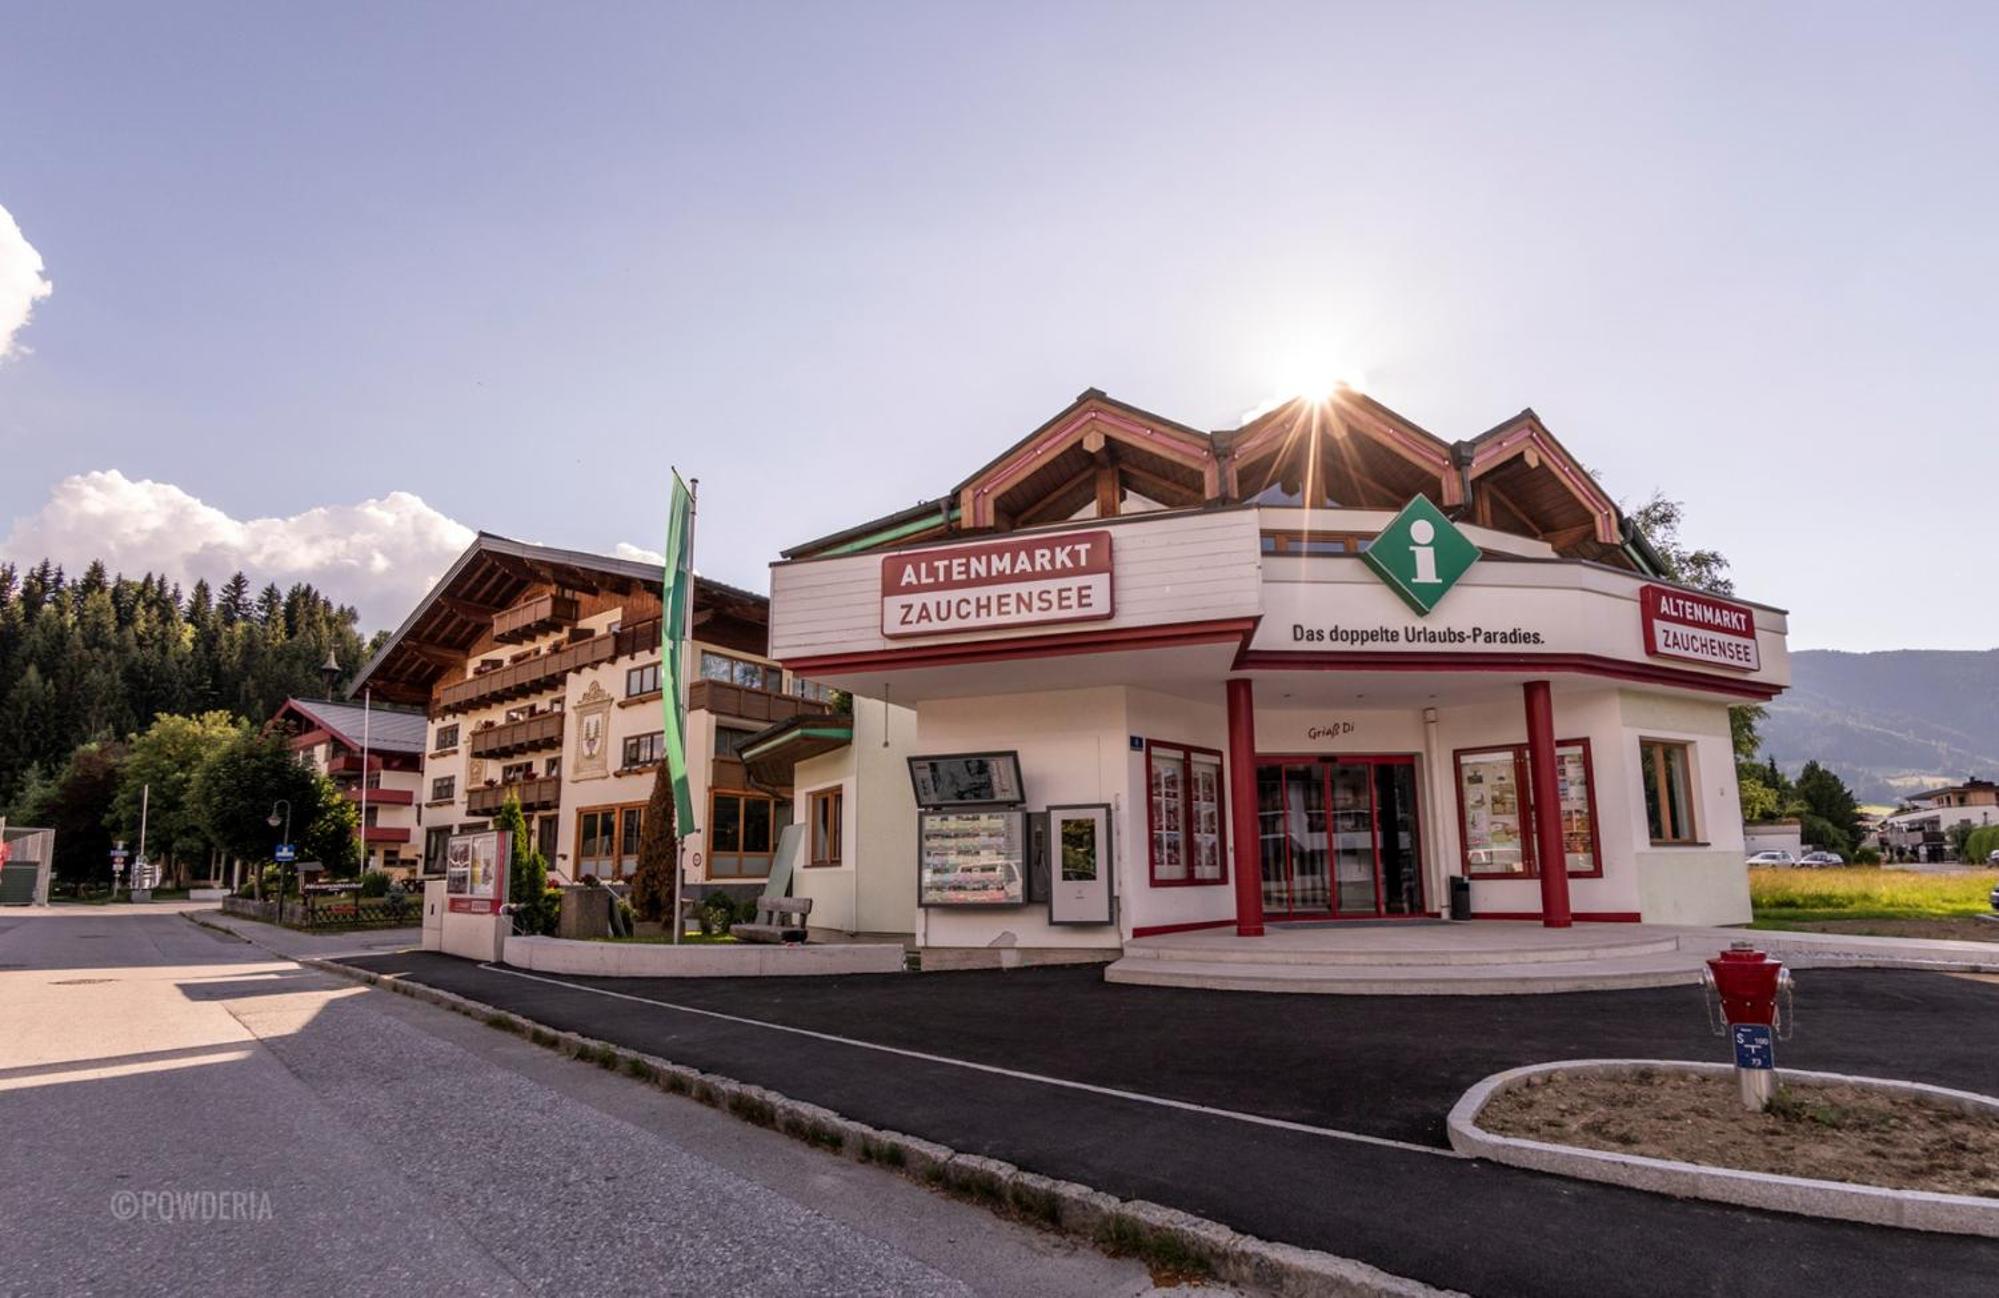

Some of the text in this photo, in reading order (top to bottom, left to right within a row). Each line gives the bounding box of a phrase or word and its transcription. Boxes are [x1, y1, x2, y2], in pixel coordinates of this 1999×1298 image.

[900, 543, 1092, 587] ALTENMARKT
[900, 585, 1093, 626] ZAUCHENSEE
[1660, 595, 1747, 631] ALTENMARKT
[1292, 624, 1545, 646] Das doppelte Urlaubs-Paradies.
[1662, 629, 1752, 662] ZAUCHENSEE
[1308, 721, 1355, 740] Griaß Di
[1736, 1032, 1745, 1044] S
